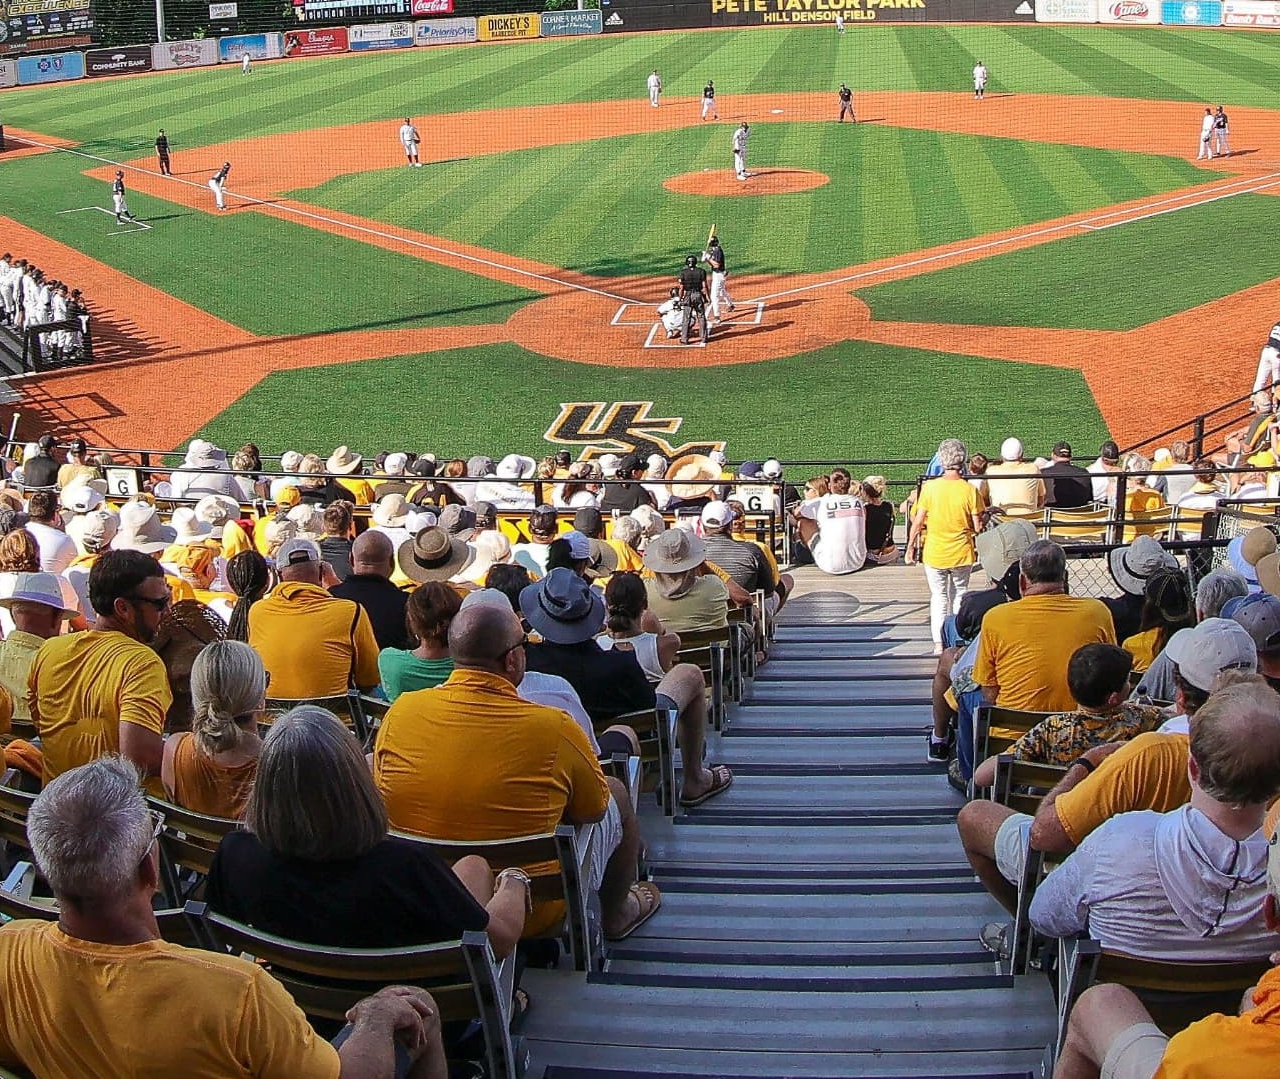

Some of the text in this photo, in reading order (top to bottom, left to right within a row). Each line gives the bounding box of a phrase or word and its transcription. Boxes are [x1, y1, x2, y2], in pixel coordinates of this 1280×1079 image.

[542, 13, 599, 23] CORNER MARKET
[764, 10, 876, 22] HILL DENSON FIELD
[488, 16, 530, 31] DICKEY'S
[430, 26, 475, 37] PriorityOne
[92, 59, 146, 70] COMMUNITY BANK
[118, 480, 129, 496] G
[748, 496, 761, 511] G
[827, 501, 861, 510] USA
